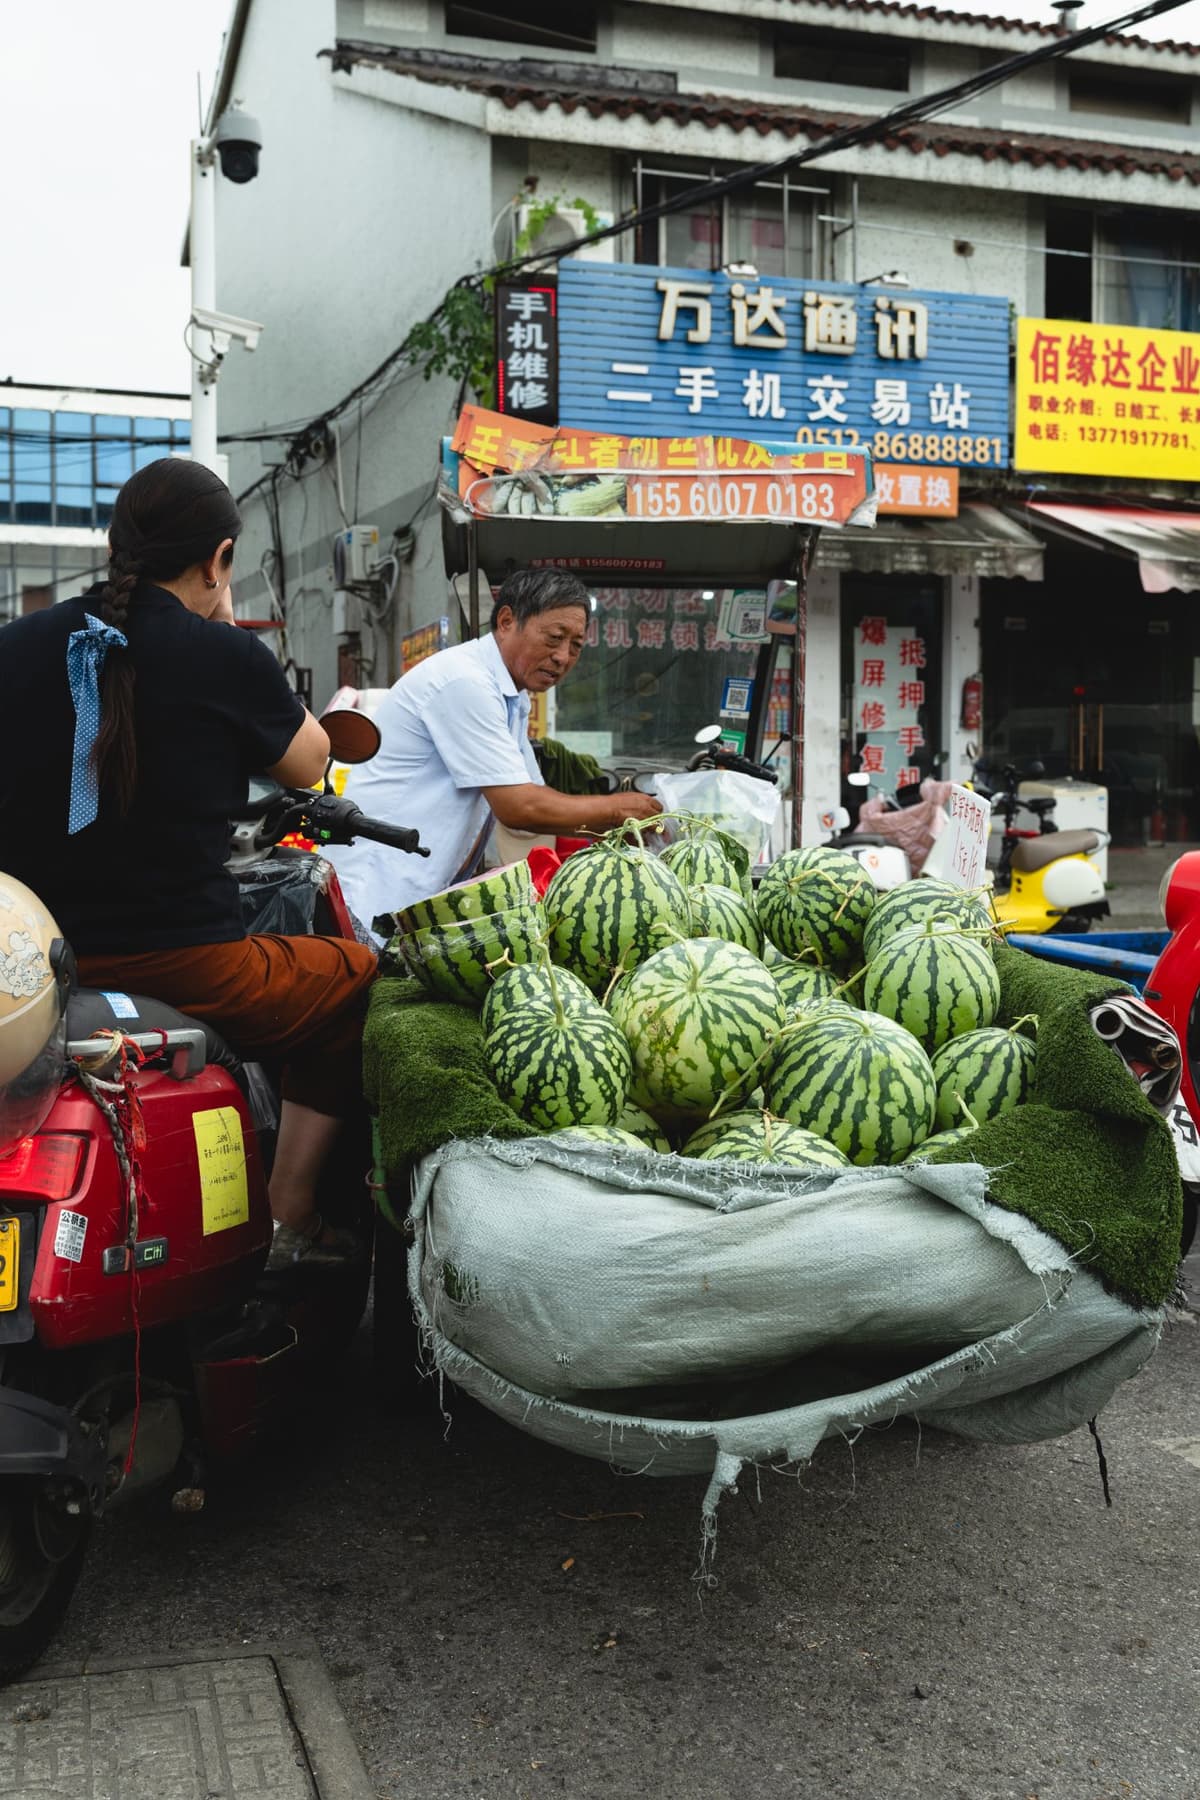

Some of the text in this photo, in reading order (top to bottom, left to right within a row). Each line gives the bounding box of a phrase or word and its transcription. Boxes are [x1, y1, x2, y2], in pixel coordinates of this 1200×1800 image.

[505, 291, 549, 410] 手机维修
[656, 278, 928, 360] 万达通讯
[605, 361, 971, 429] 二手机交易站
[1029, 330, 1200, 396] 佰缘达企业
[1027, 394, 1200, 424] 职业介绍：日结工、长
[796, 426, 1002, 464] 0512-86888881
[631, 481, 836, 518] 155 6007 0183
[859, 615, 887, 774] 爆屏修复
[896, 637, 926, 790] 抵押手机
